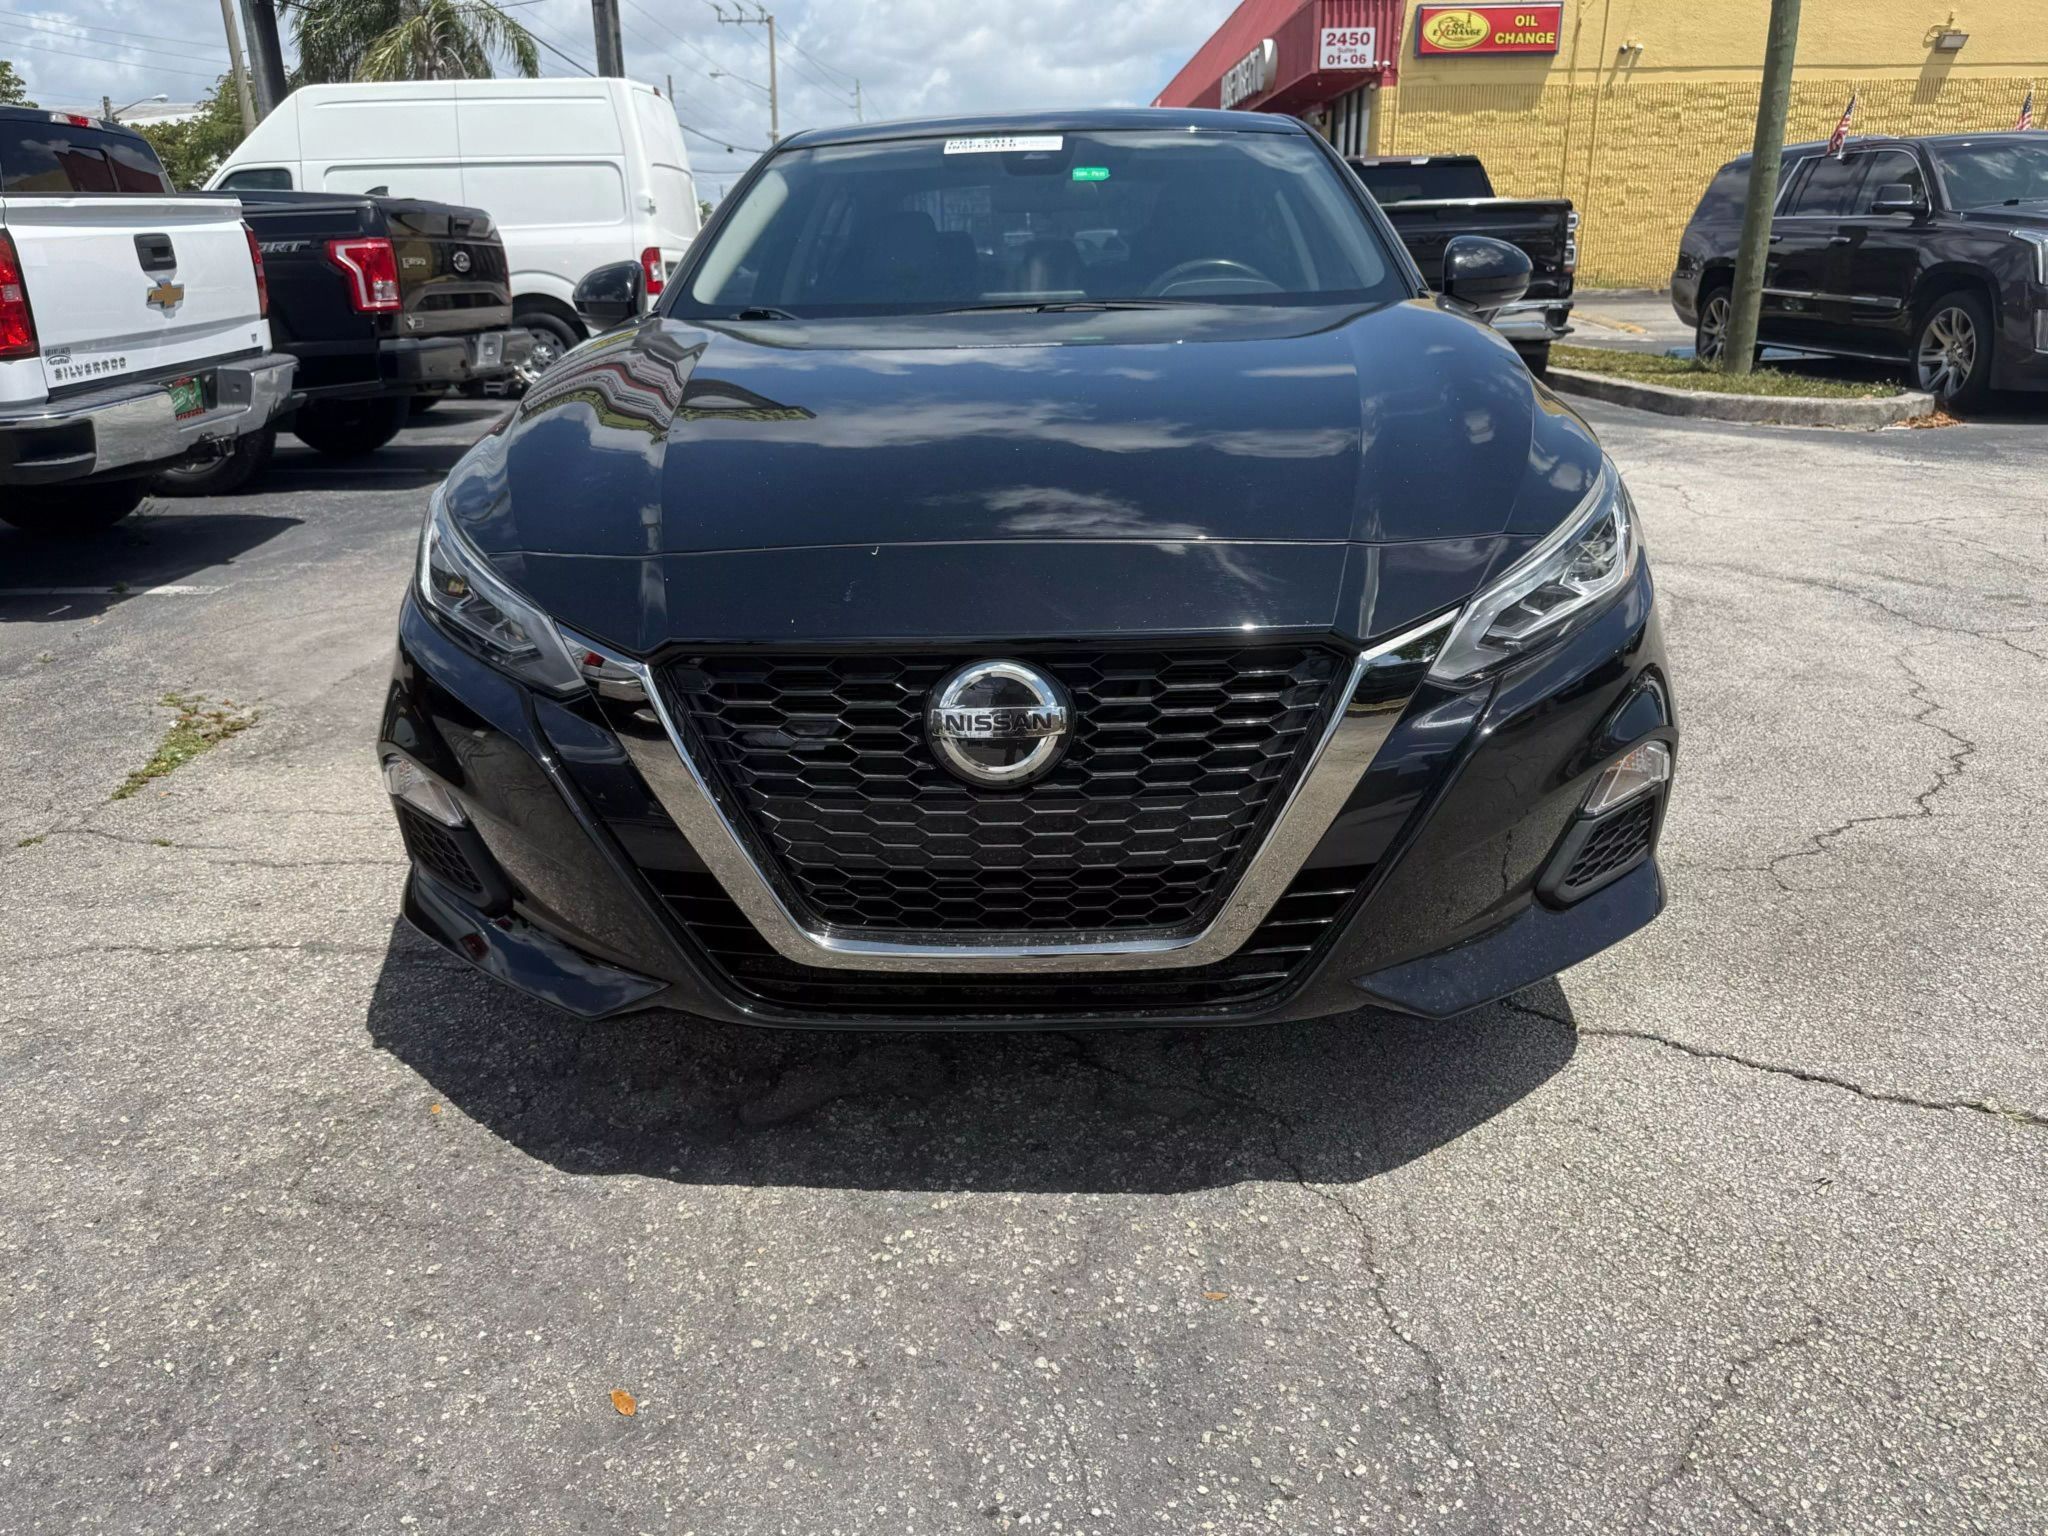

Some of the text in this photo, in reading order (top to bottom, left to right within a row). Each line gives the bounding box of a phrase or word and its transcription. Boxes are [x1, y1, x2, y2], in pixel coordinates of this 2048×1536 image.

[1514, 15, 1538, 27] OIL
[1326, 32, 1371, 46] 2450
[1494, 32, 1555, 44] CHANGE
[54, 357, 127, 380] SILVERADO
[945, 712, 1053, 732] NISSAN
